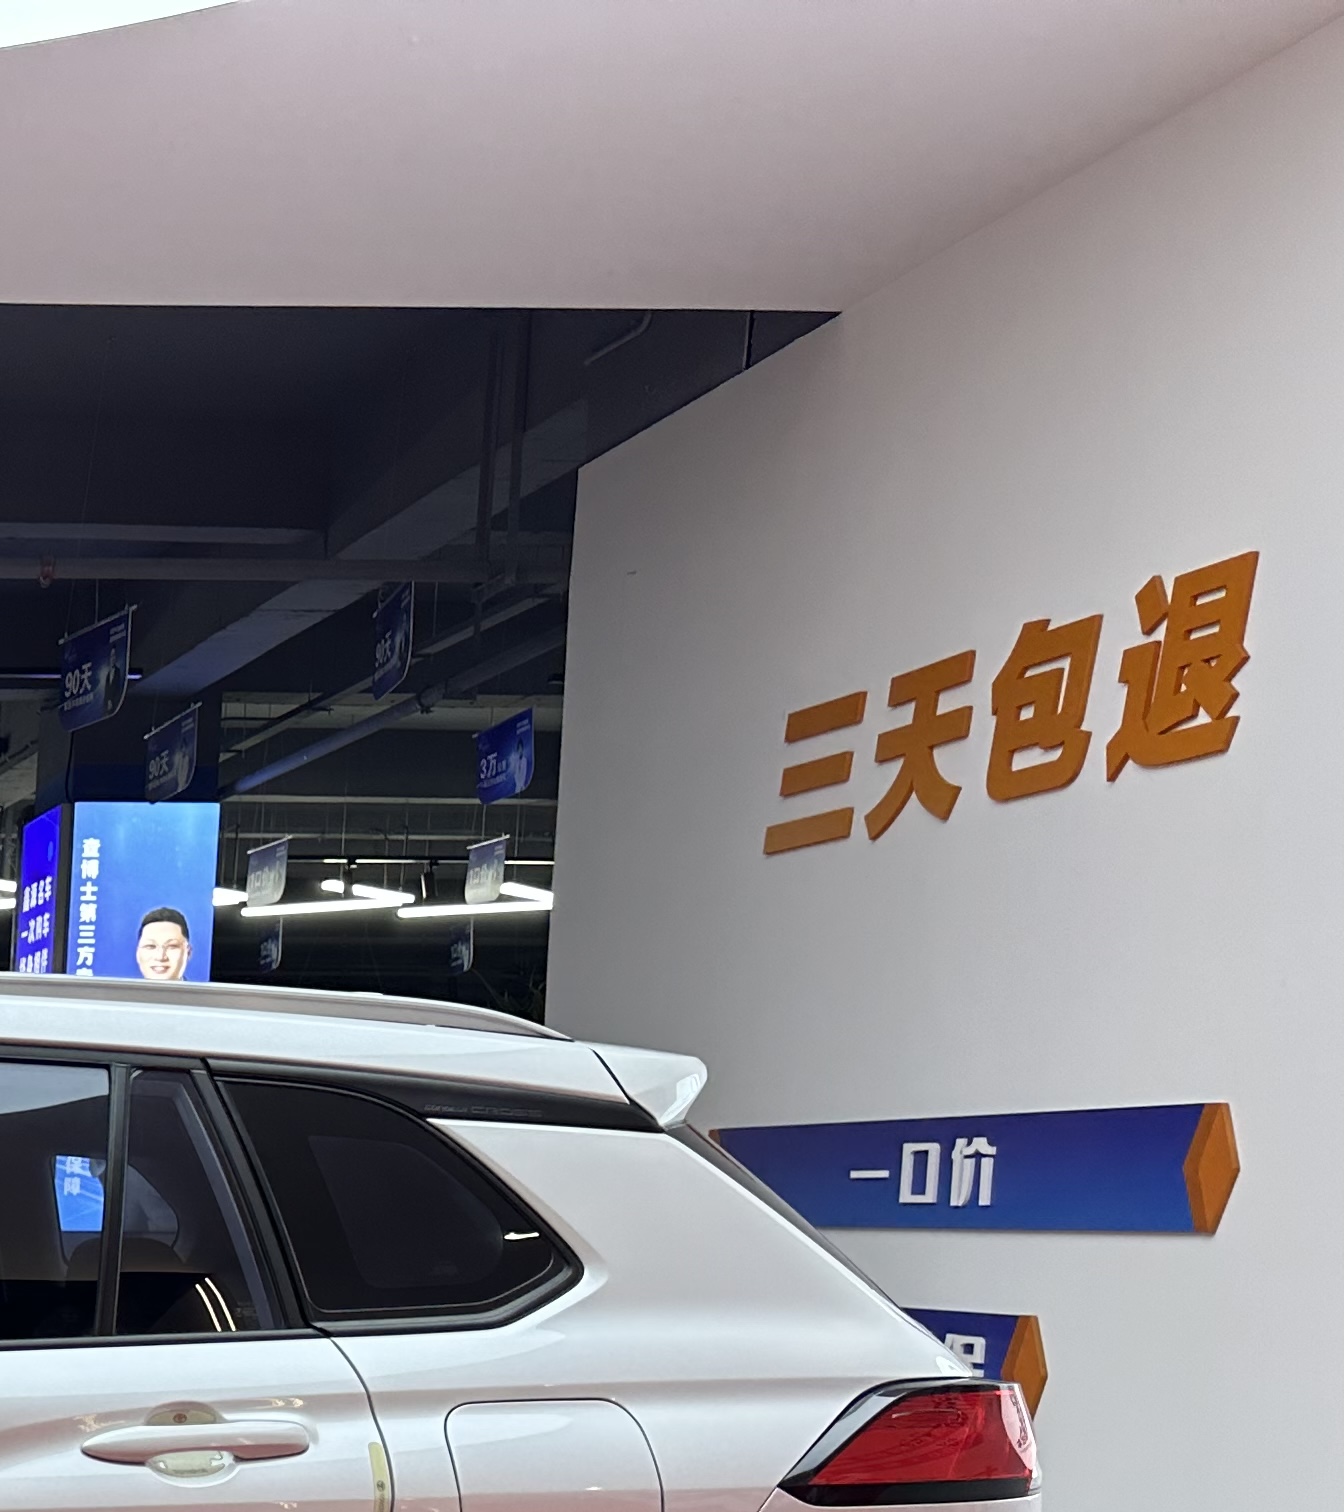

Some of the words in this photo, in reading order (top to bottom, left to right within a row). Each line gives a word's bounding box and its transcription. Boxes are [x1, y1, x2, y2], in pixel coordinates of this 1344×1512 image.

[64, 661, 92, 698] 90天
[763, 551, 1260, 855] 三天包退
[149, 749, 169, 780] 90天
[849, 1136, 997, 1207] 一口价
